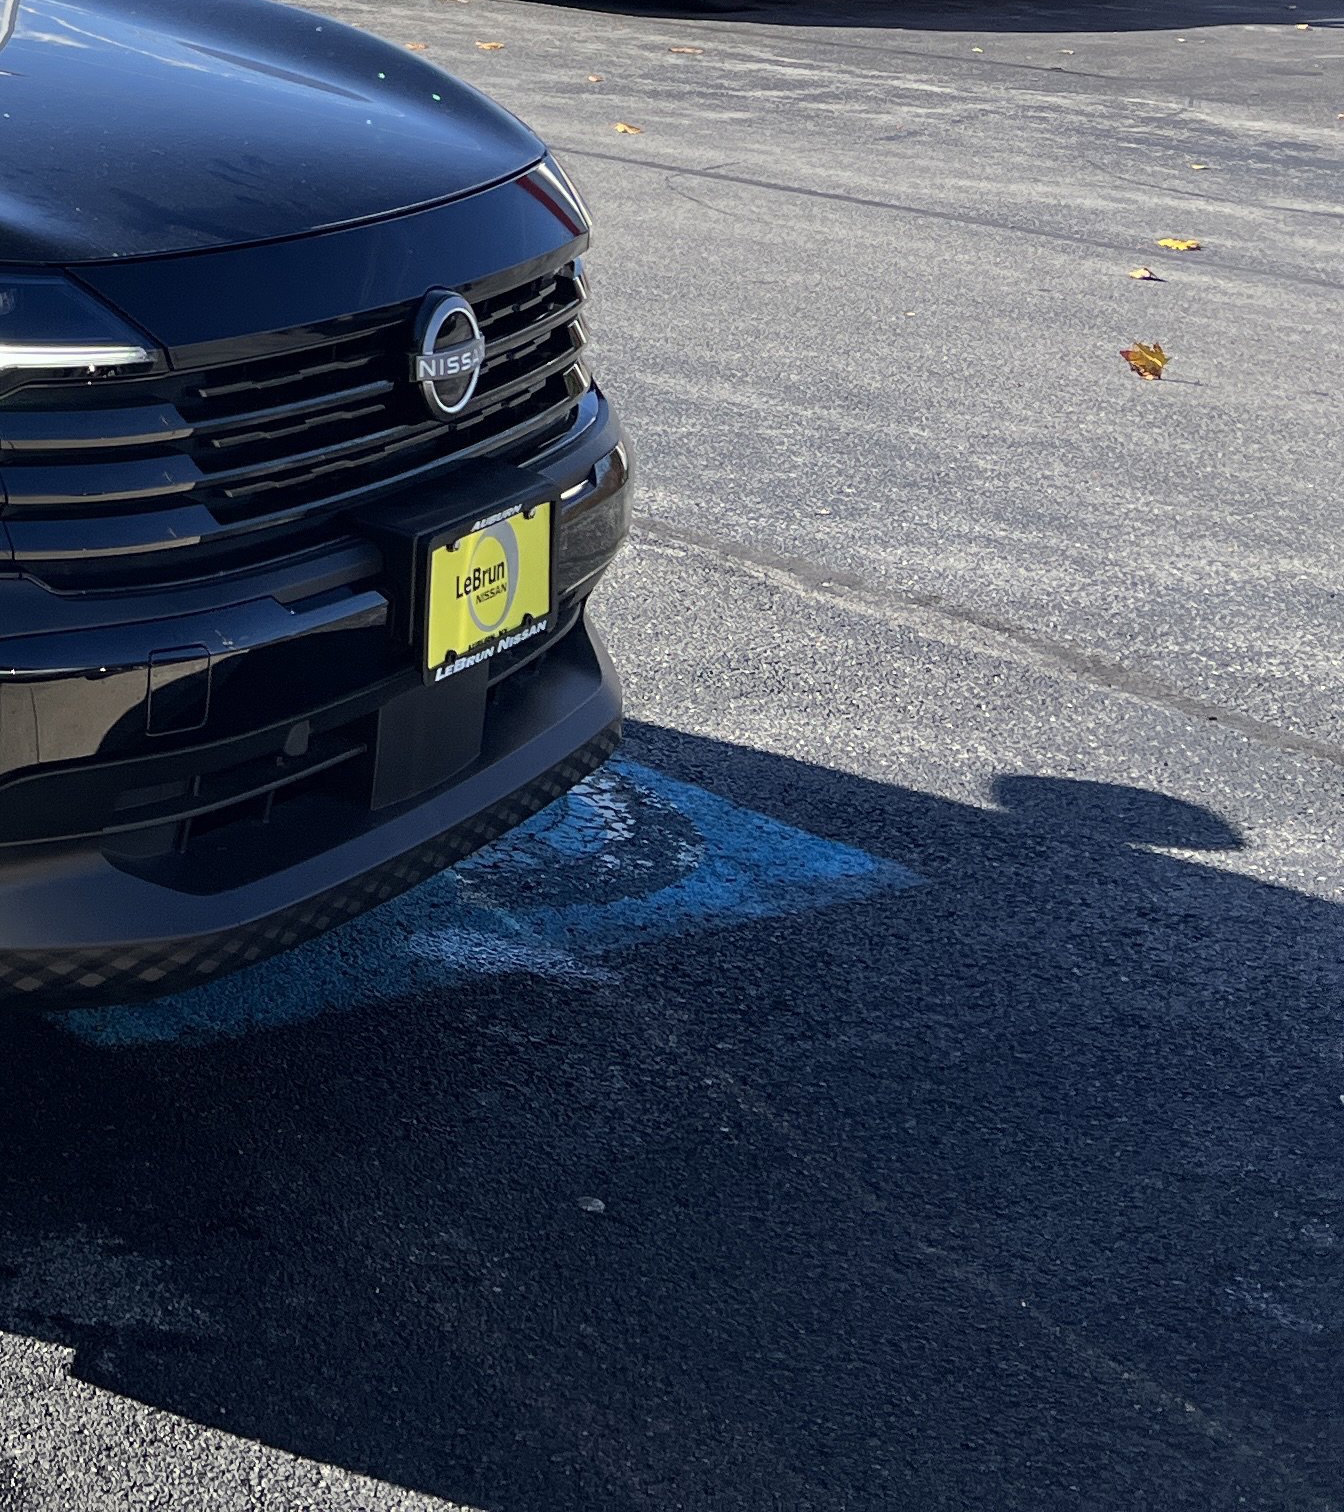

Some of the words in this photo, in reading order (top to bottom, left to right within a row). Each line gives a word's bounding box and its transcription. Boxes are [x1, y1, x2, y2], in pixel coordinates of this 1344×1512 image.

[455, 561, 506, 600] LeBrun
[475, 583, 508, 605] NISSAN
[497, 619, 547, 654] NISSAN
